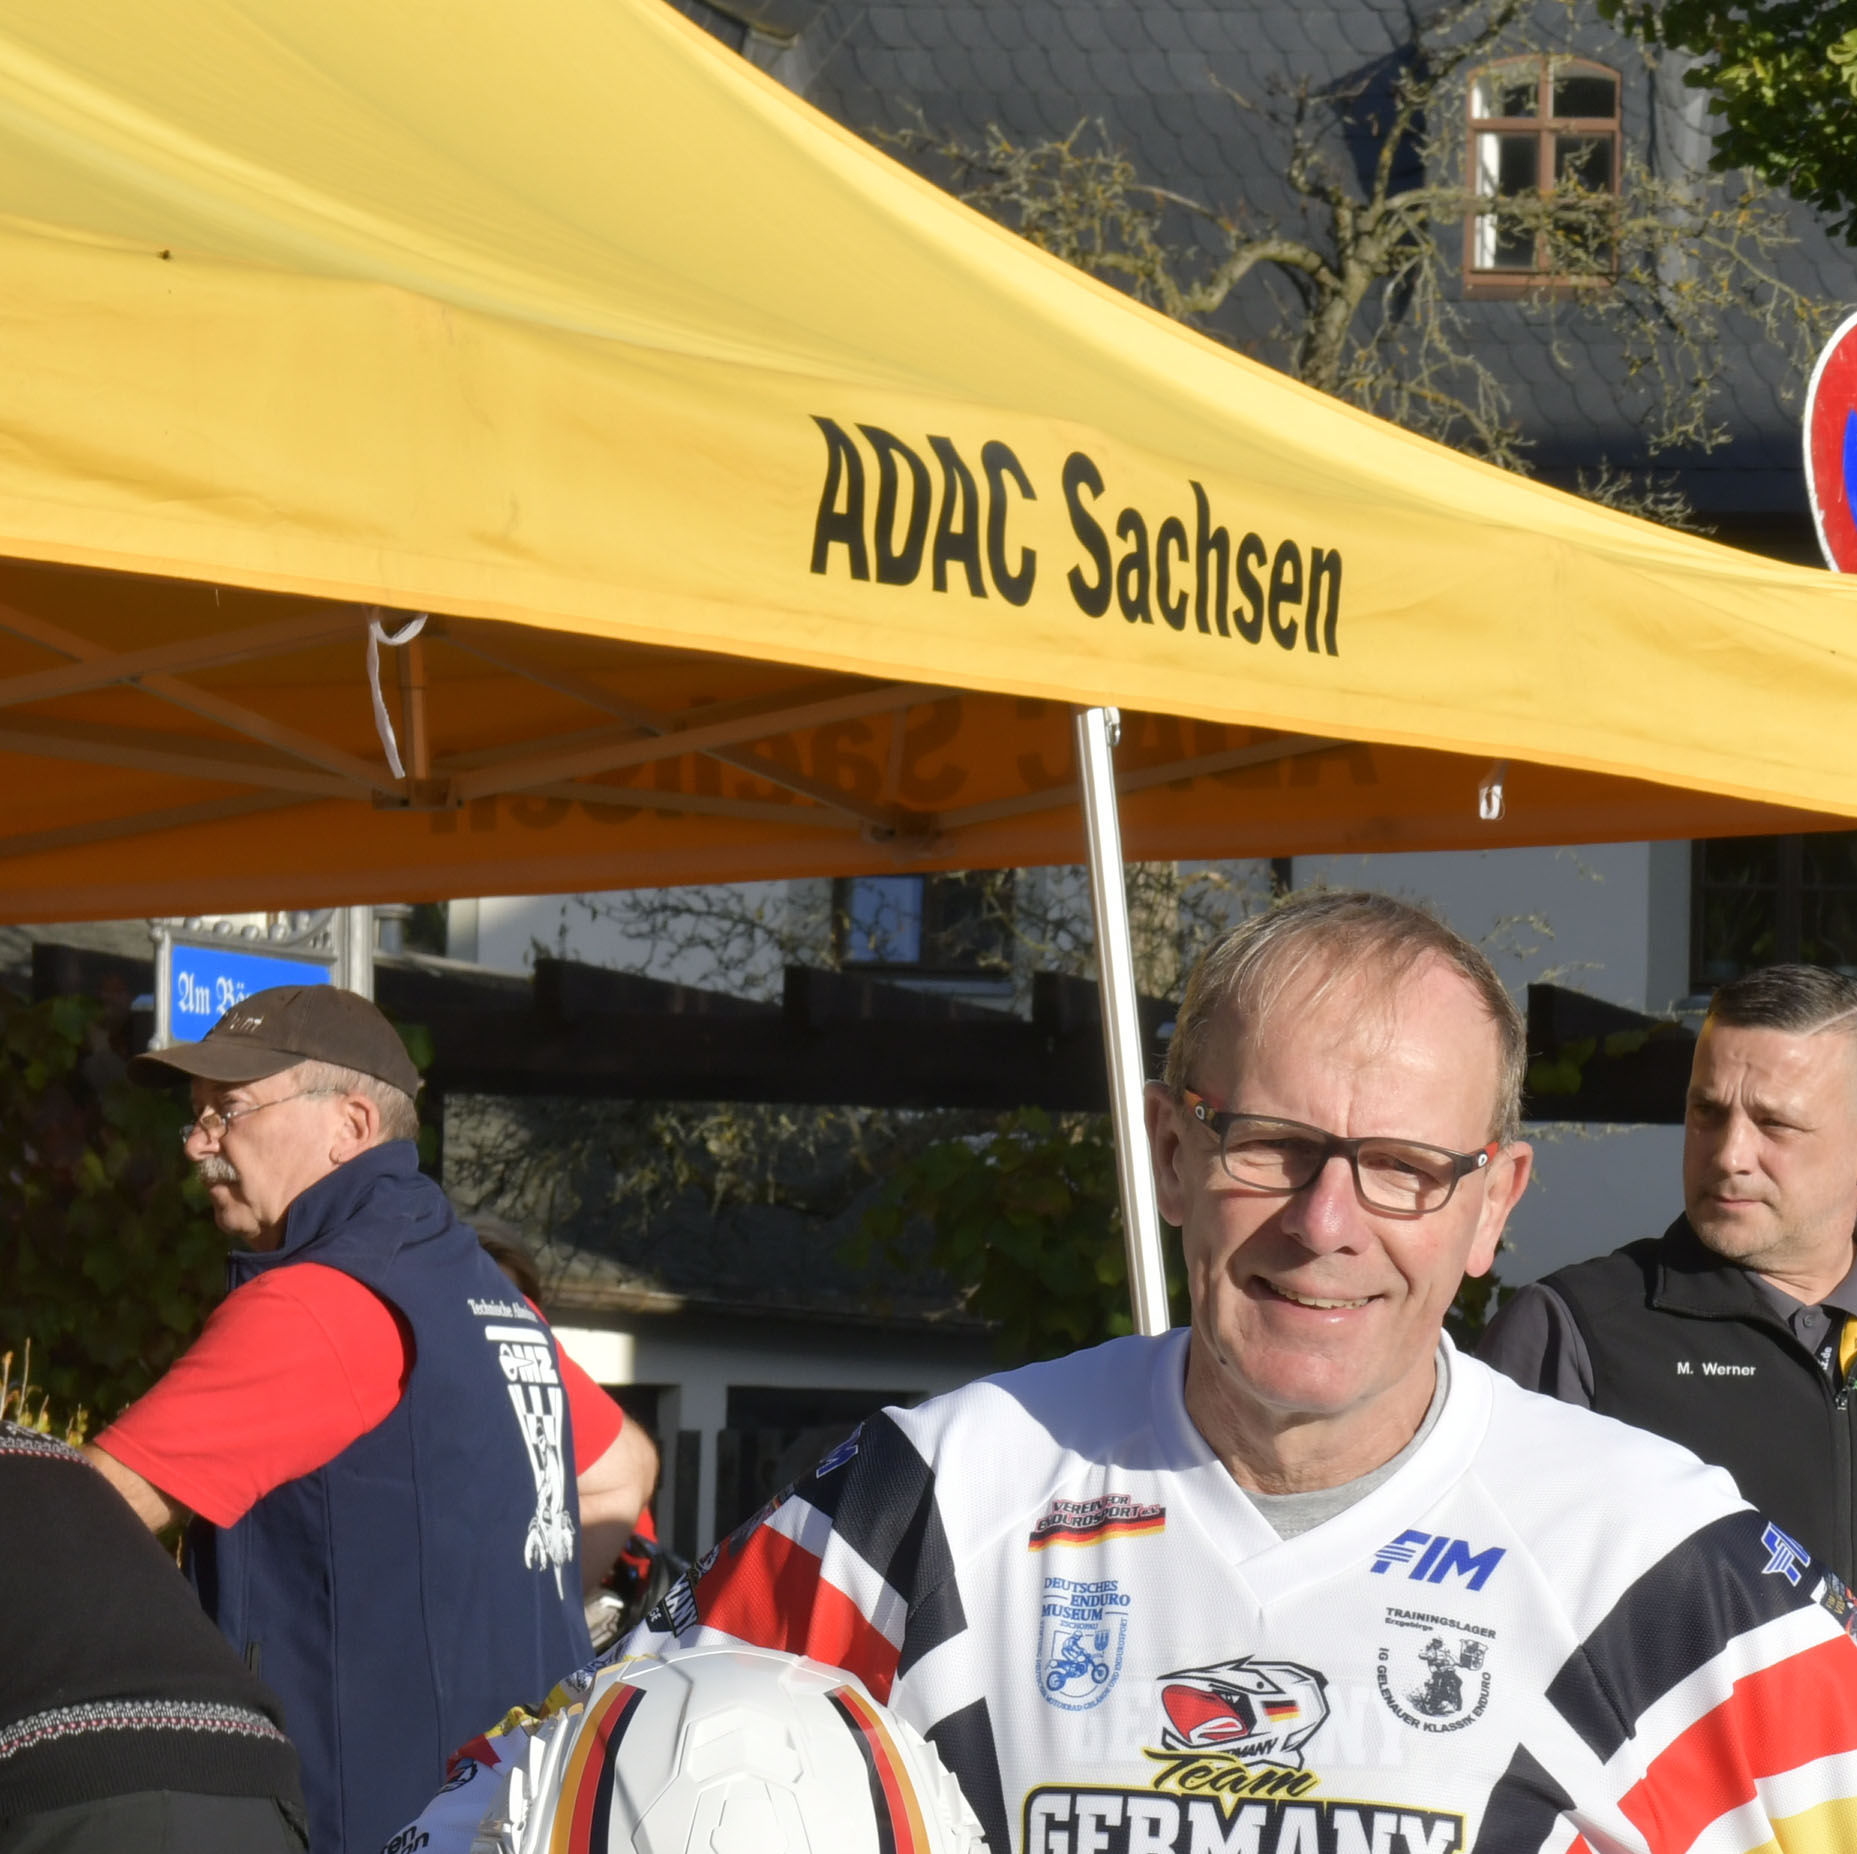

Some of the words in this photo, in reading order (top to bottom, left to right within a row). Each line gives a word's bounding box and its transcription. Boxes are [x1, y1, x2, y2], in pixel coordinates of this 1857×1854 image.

[811, 414, 1038, 607] ADAC
[1062, 450, 1343, 656] Sachsen
[178, 970, 211, 1015] Am
[1677, 1361, 1694, 1376] M.
[1702, 1361, 1757, 1378] Werner
[1037, 1505, 1140, 1533] ENDUROSPORT
[1053, 1497, 1101, 1515] VEREIN
[1370, 1529, 1507, 1592] FIM
[1044, 1577, 1118, 1594] DEUTSCHES
[1070, 1593, 1131, 1608] ENDURO
[1042, 1604, 1103, 1621] MUSEUM
[1386, 1607, 1497, 1640] TRAININGSLAGER
[1471, 1671, 1492, 1720] ENDURO
[1144, 1748, 1320, 1798] Team
